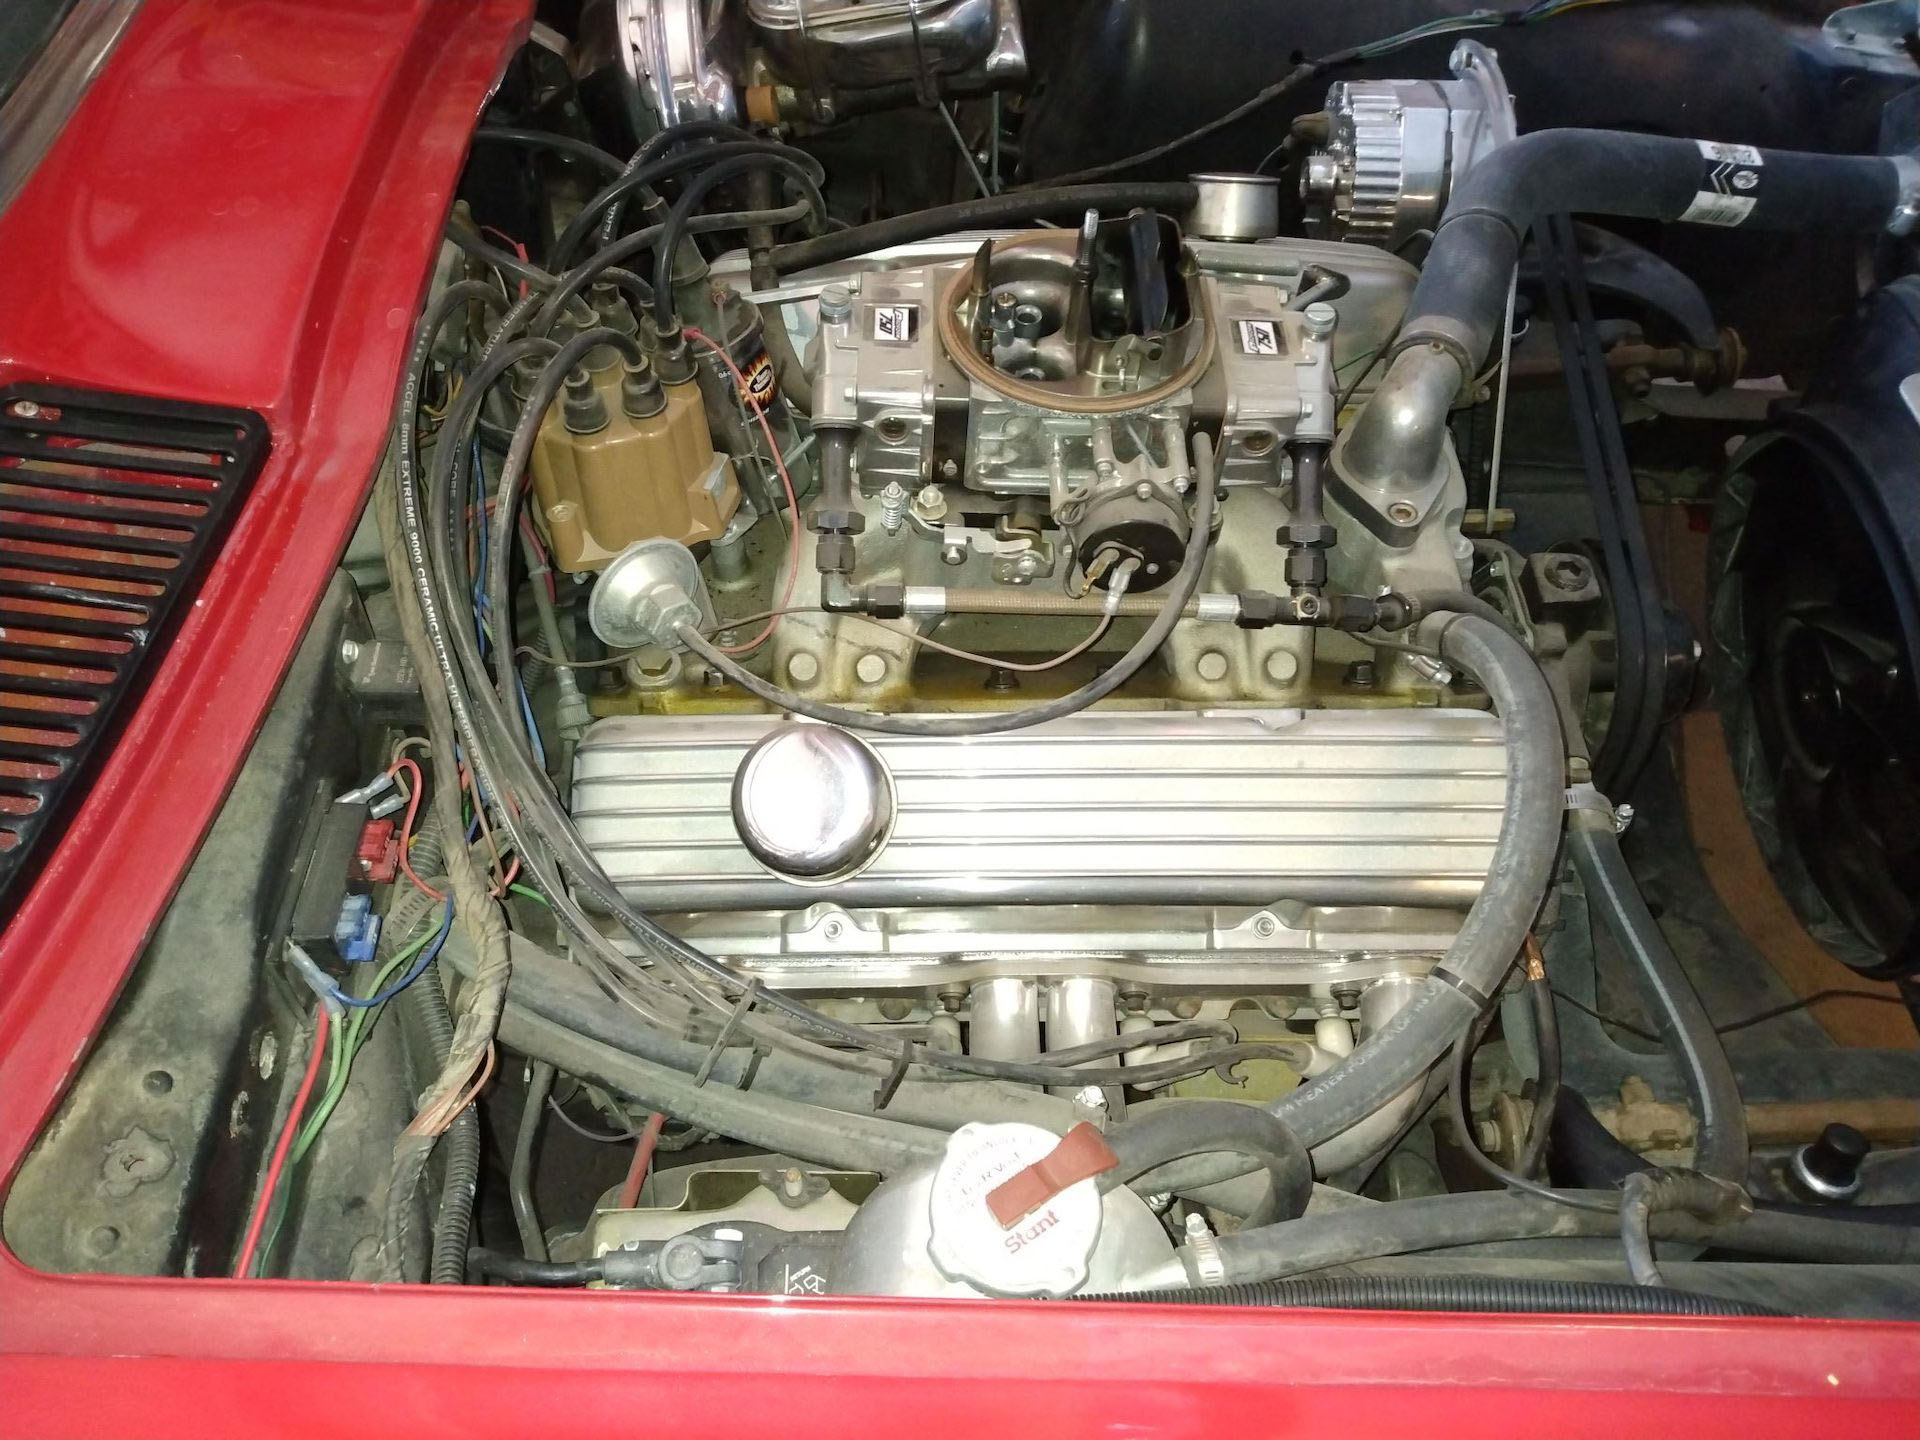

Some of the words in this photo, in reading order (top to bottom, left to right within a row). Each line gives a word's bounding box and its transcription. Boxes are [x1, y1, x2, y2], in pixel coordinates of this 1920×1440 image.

[402, 372, 416, 416] ACCEL
[401, 423, 411, 454] 8mm
[401, 460, 417, 528] EXTREME
[410, 532, 423, 564] 9000
[417, 567, 439, 632] CERAMIC
[433, 635, 453, 681] ULTRA
[1296, 1071, 1347, 1107] HEATER
[1004, 1209, 1061, 1255] Stant
